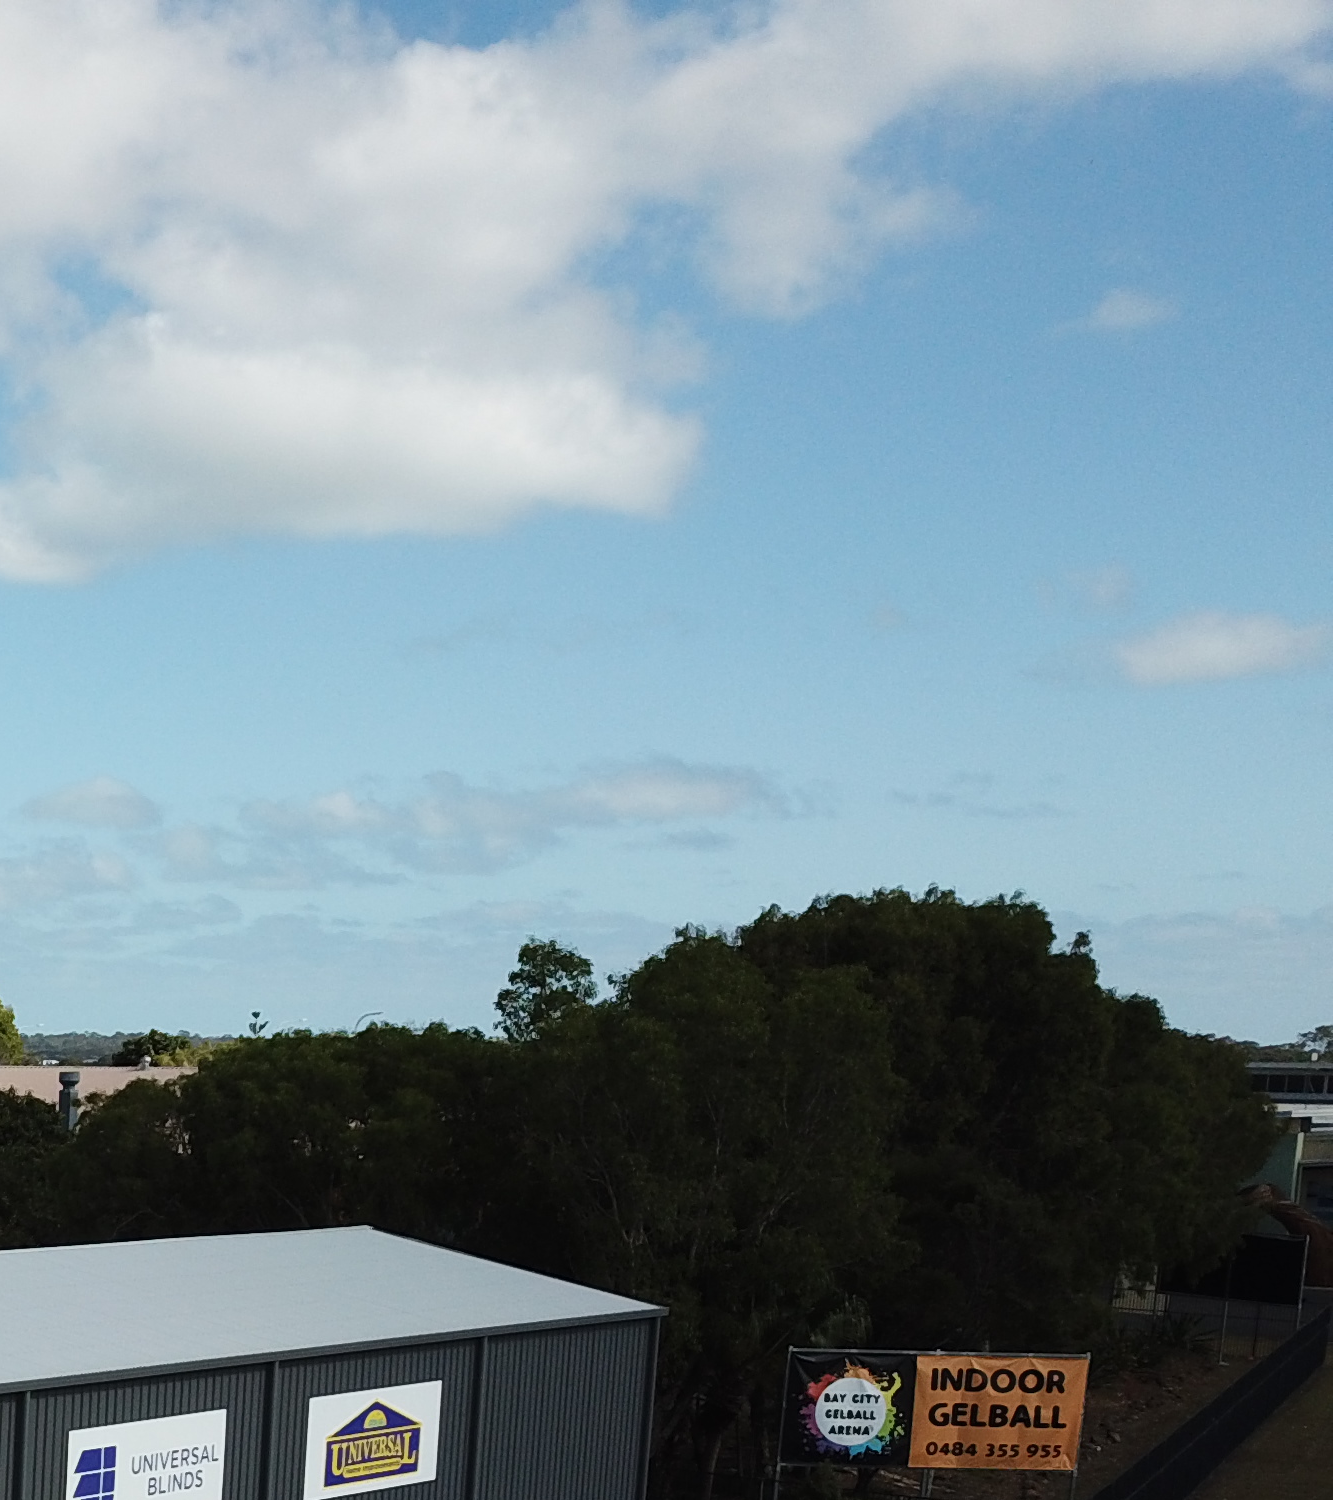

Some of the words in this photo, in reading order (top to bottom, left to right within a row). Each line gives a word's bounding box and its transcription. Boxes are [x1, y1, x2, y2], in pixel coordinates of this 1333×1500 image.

[931, 1367, 1065, 1394] INDOOR
[852, 1394, 881, 1404] CITY
[928, 1403, 1067, 1428] GELBALL
[828, 1425, 870, 1435] ARENA
[131, 1444, 219, 1475] UNIVERSAL
[331, 1432, 416, 1476] UNIVERSAL
[925, 1441, 978, 1457] 0484
[985, 1443, 1019, 1458] 355
[1026, 1444, 1062, 1458] 955
[148, 1470, 203, 1496] BLINDS
